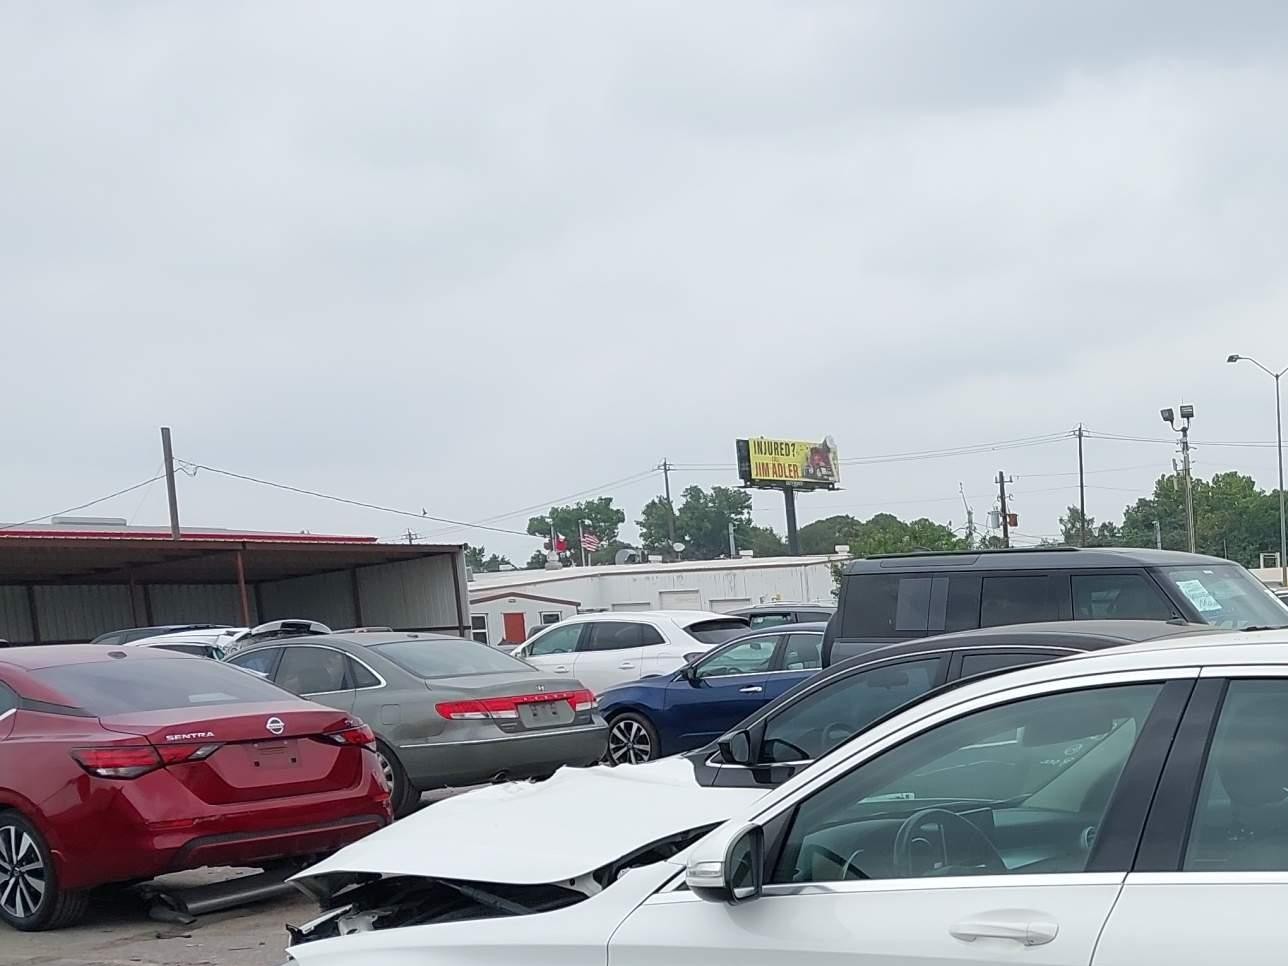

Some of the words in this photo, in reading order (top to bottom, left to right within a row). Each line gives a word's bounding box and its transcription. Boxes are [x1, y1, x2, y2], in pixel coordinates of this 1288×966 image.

[753, 440, 796, 457] INJURED?
[755, 461, 770, 477] JIM
[772, 462, 800, 478] ADLER
[165, 731, 215, 742] SENTRA
